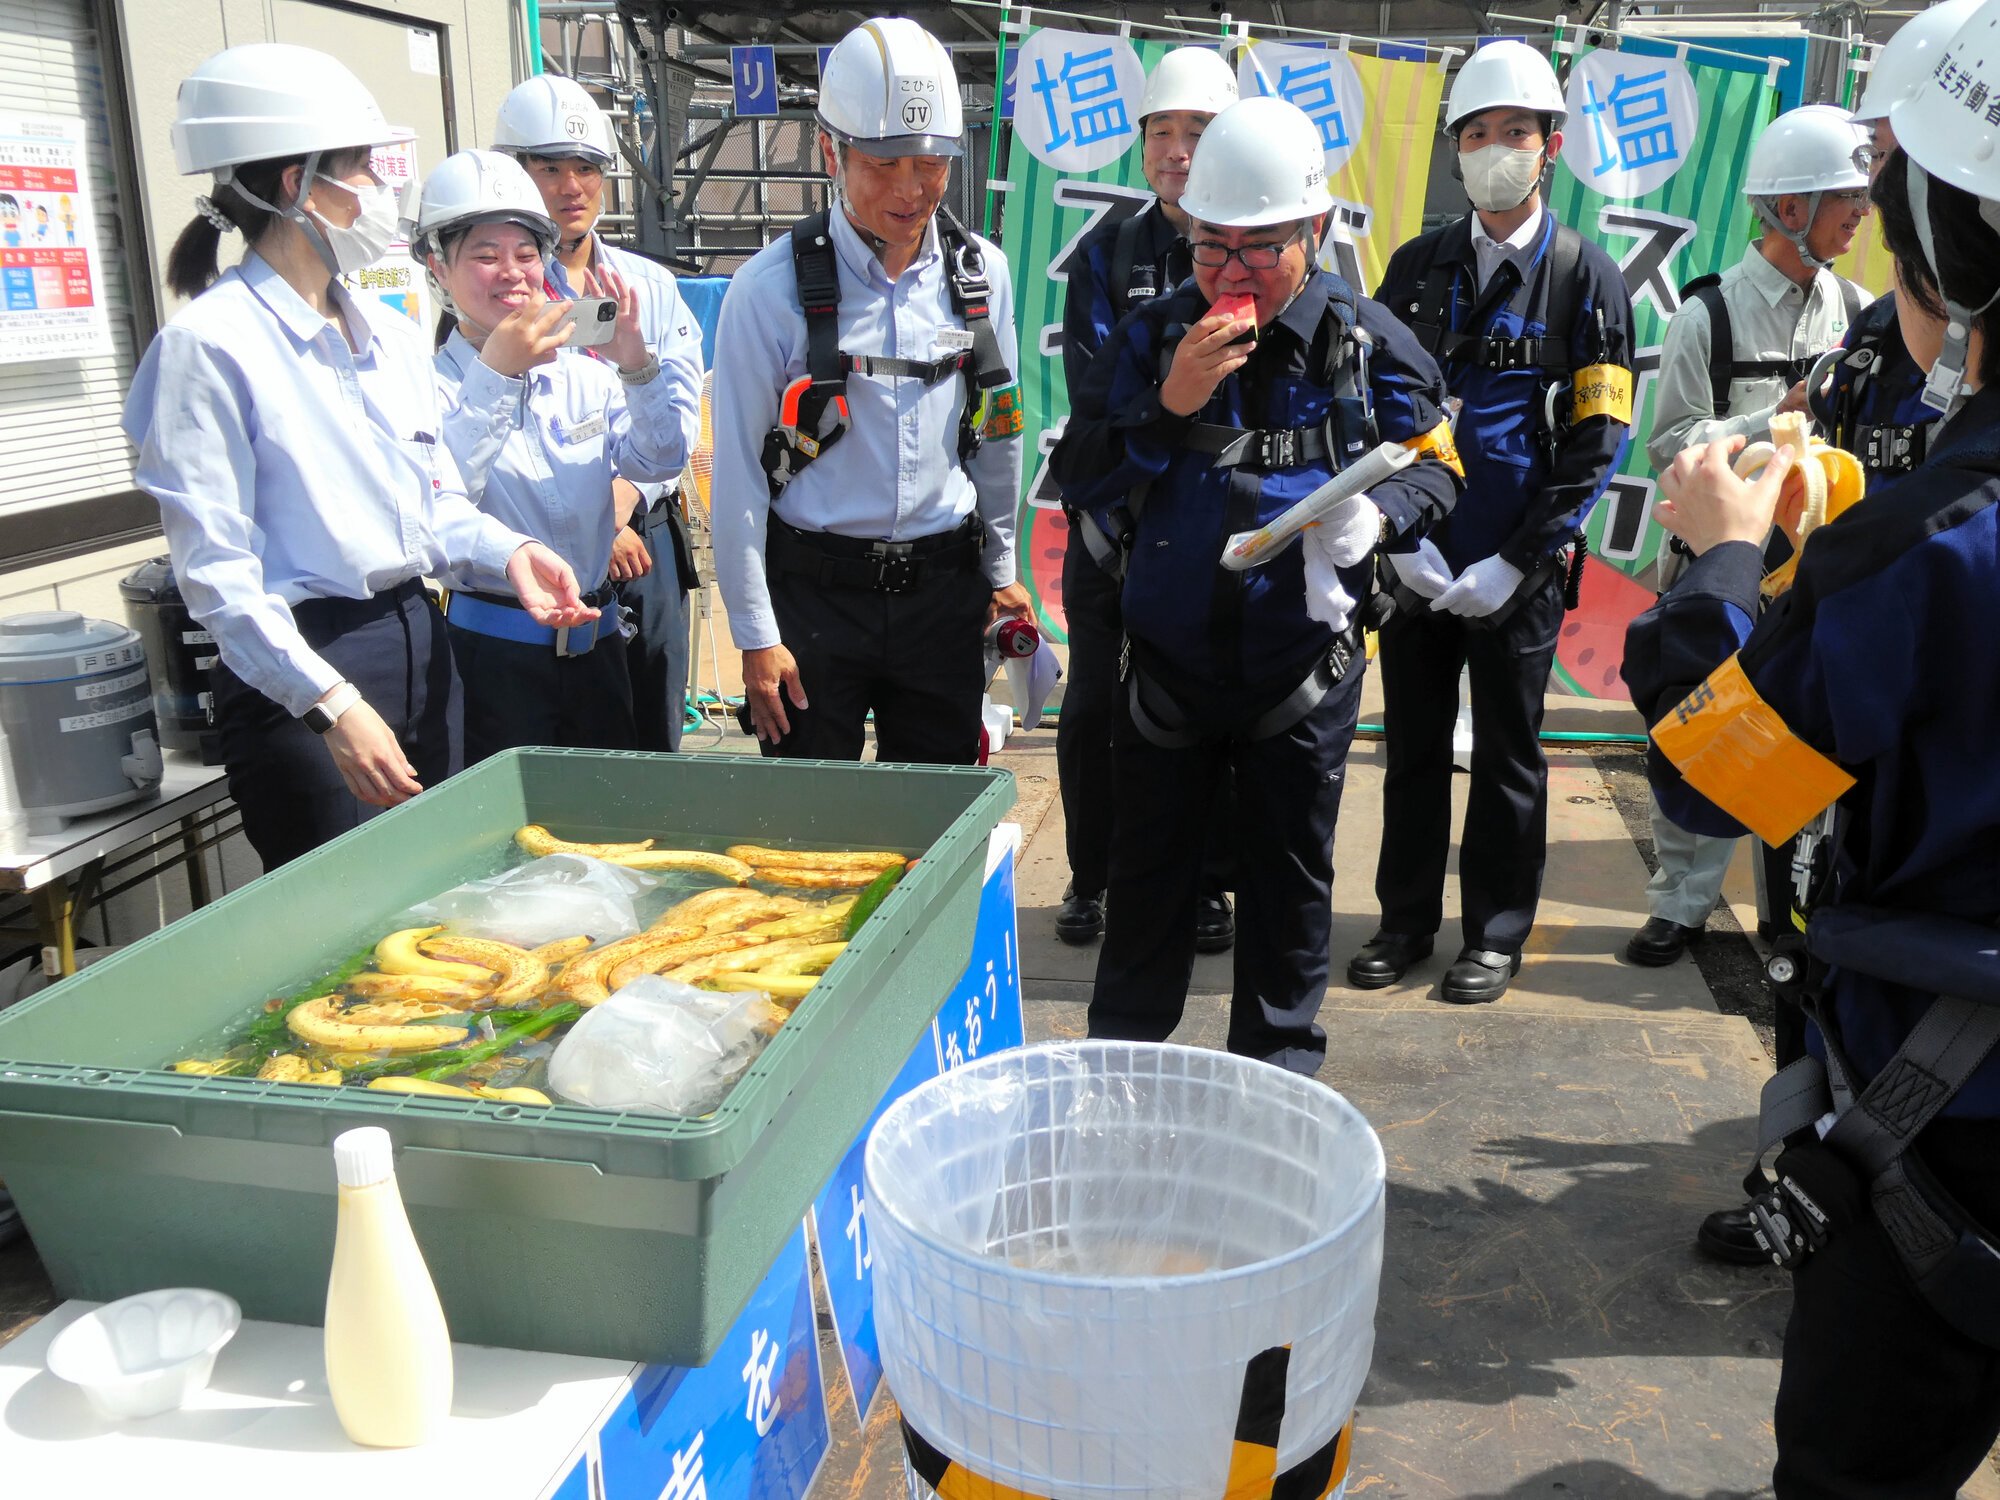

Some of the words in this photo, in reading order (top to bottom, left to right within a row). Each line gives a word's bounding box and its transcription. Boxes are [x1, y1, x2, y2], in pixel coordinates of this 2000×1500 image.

[901, 80, 935, 92] こひら
[1031, 47, 1132, 153] 塩
[906, 106, 928, 123] JV
[568, 121, 585, 135] JV
[1581, 70, 1679, 177] 塩
